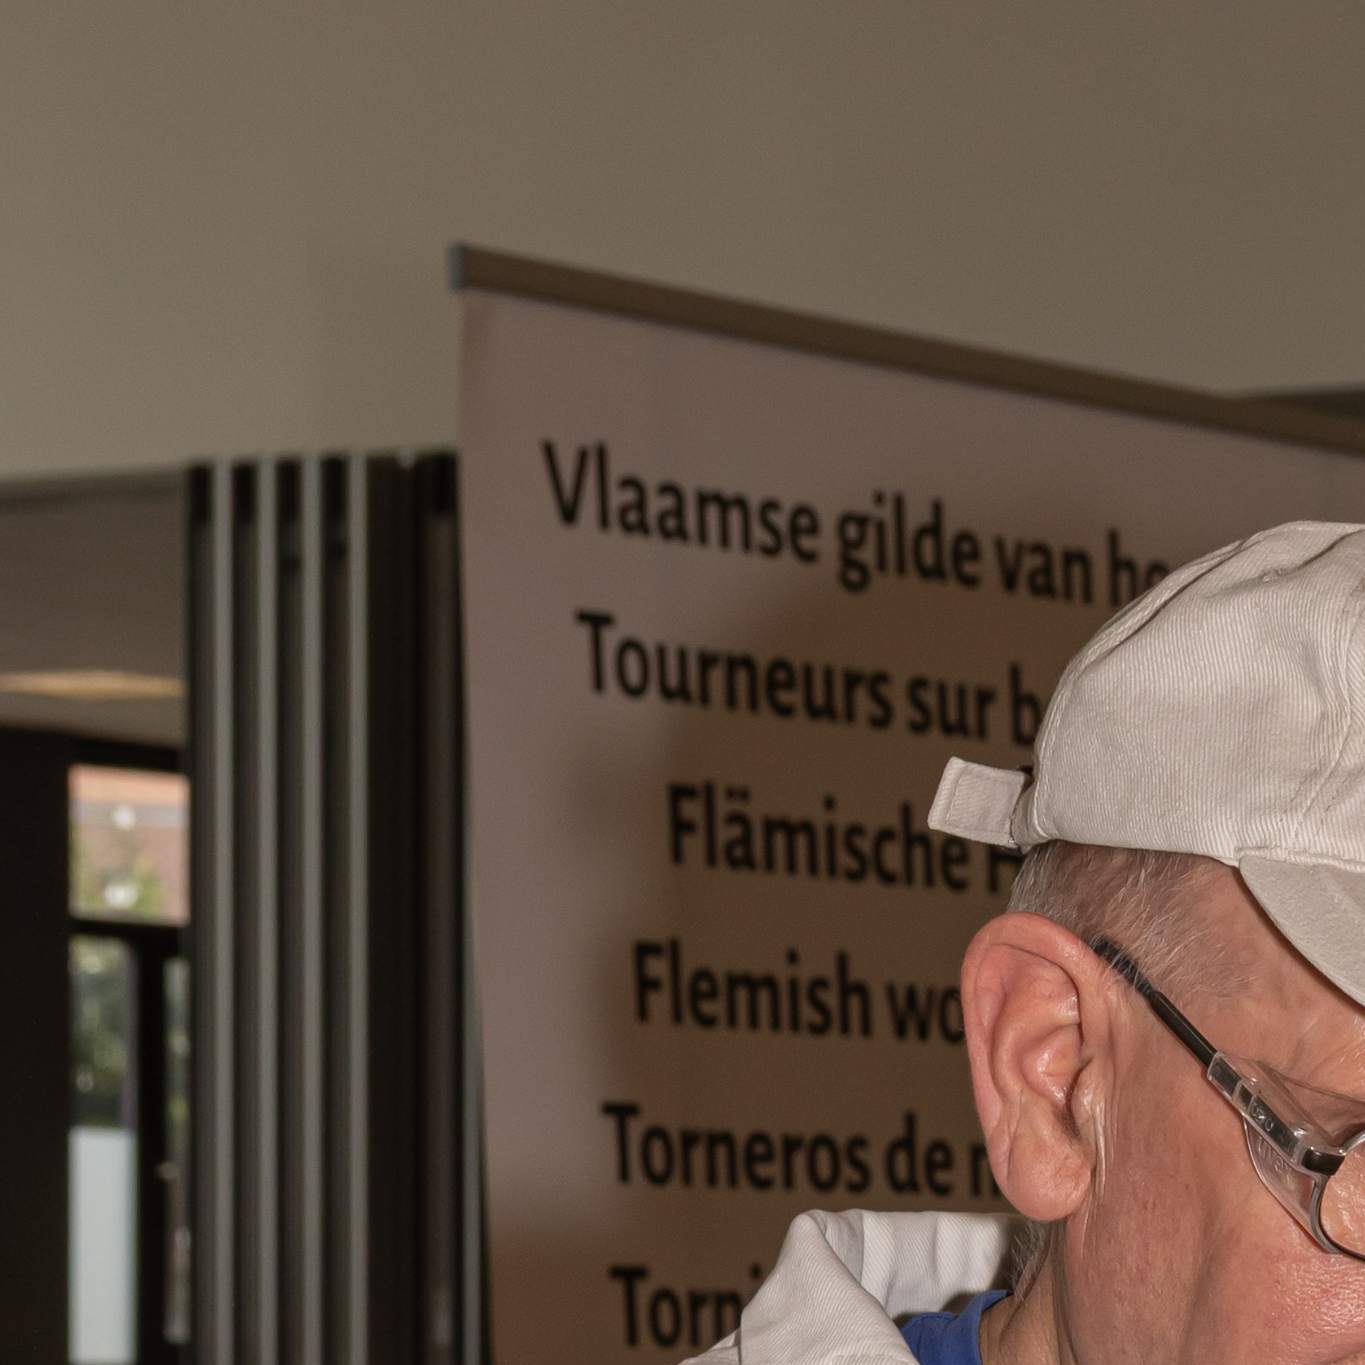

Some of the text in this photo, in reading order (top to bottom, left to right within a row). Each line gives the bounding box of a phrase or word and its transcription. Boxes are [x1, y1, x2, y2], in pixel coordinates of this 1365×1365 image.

[543, 439, 819, 564] Vlaamse
[838, 492, 981, 592] gilde
[994, 537, 1094, 604] van
[576, 610, 893, 730] Tourneurs
[909, 674, 996, 745] sur
[666, 783, 969, 892] Flämische
[634, 940, 872, 1038] Flemish
[602, 1104, 871, 1194] Torneros
[886, 1111, 955, 1197] de
[609, 1263, 762, 1347] Torn
